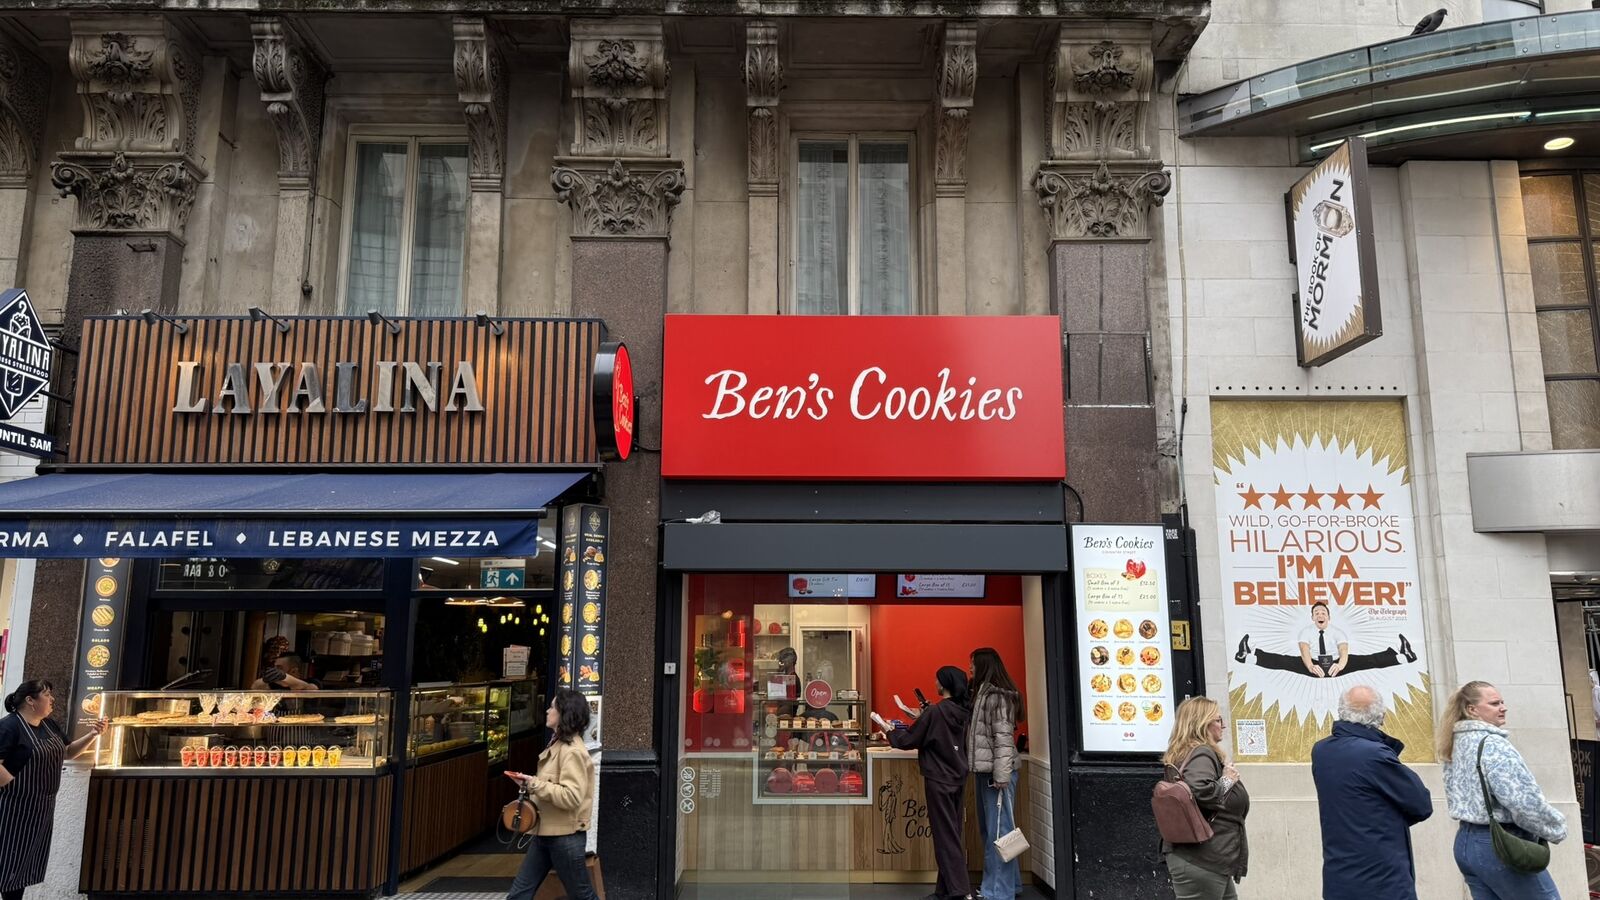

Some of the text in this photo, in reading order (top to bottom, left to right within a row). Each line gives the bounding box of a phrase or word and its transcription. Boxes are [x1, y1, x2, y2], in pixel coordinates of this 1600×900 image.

[1303, 231, 1323, 323] THE BOOK OF
[12, 361, 32, 372] STREET
[33, 368, 49, 378] FOOD
[172, 361, 485, 413] LAYALINA
[702, 366, 1023, 421] Ben's Cookies
[30, 437, 52, 452] 5AM
[1228, 514, 1400, 529] WILD, GO-FOR-BROKE
[105, 531, 213, 547] FALAFEL
[268, 530, 500, 547] LEBANESE MEZZA
[1083, 536, 1154, 549] Ben's Cookies
[1230, 529, 1406, 553] HILARIOUS.
[1277, 555, 1359, 579] I’M A
[1380, 607, 1407, 616] Telegraph
[811, 687, 828, 699] Open
[902, 799, 929, 818] Be
